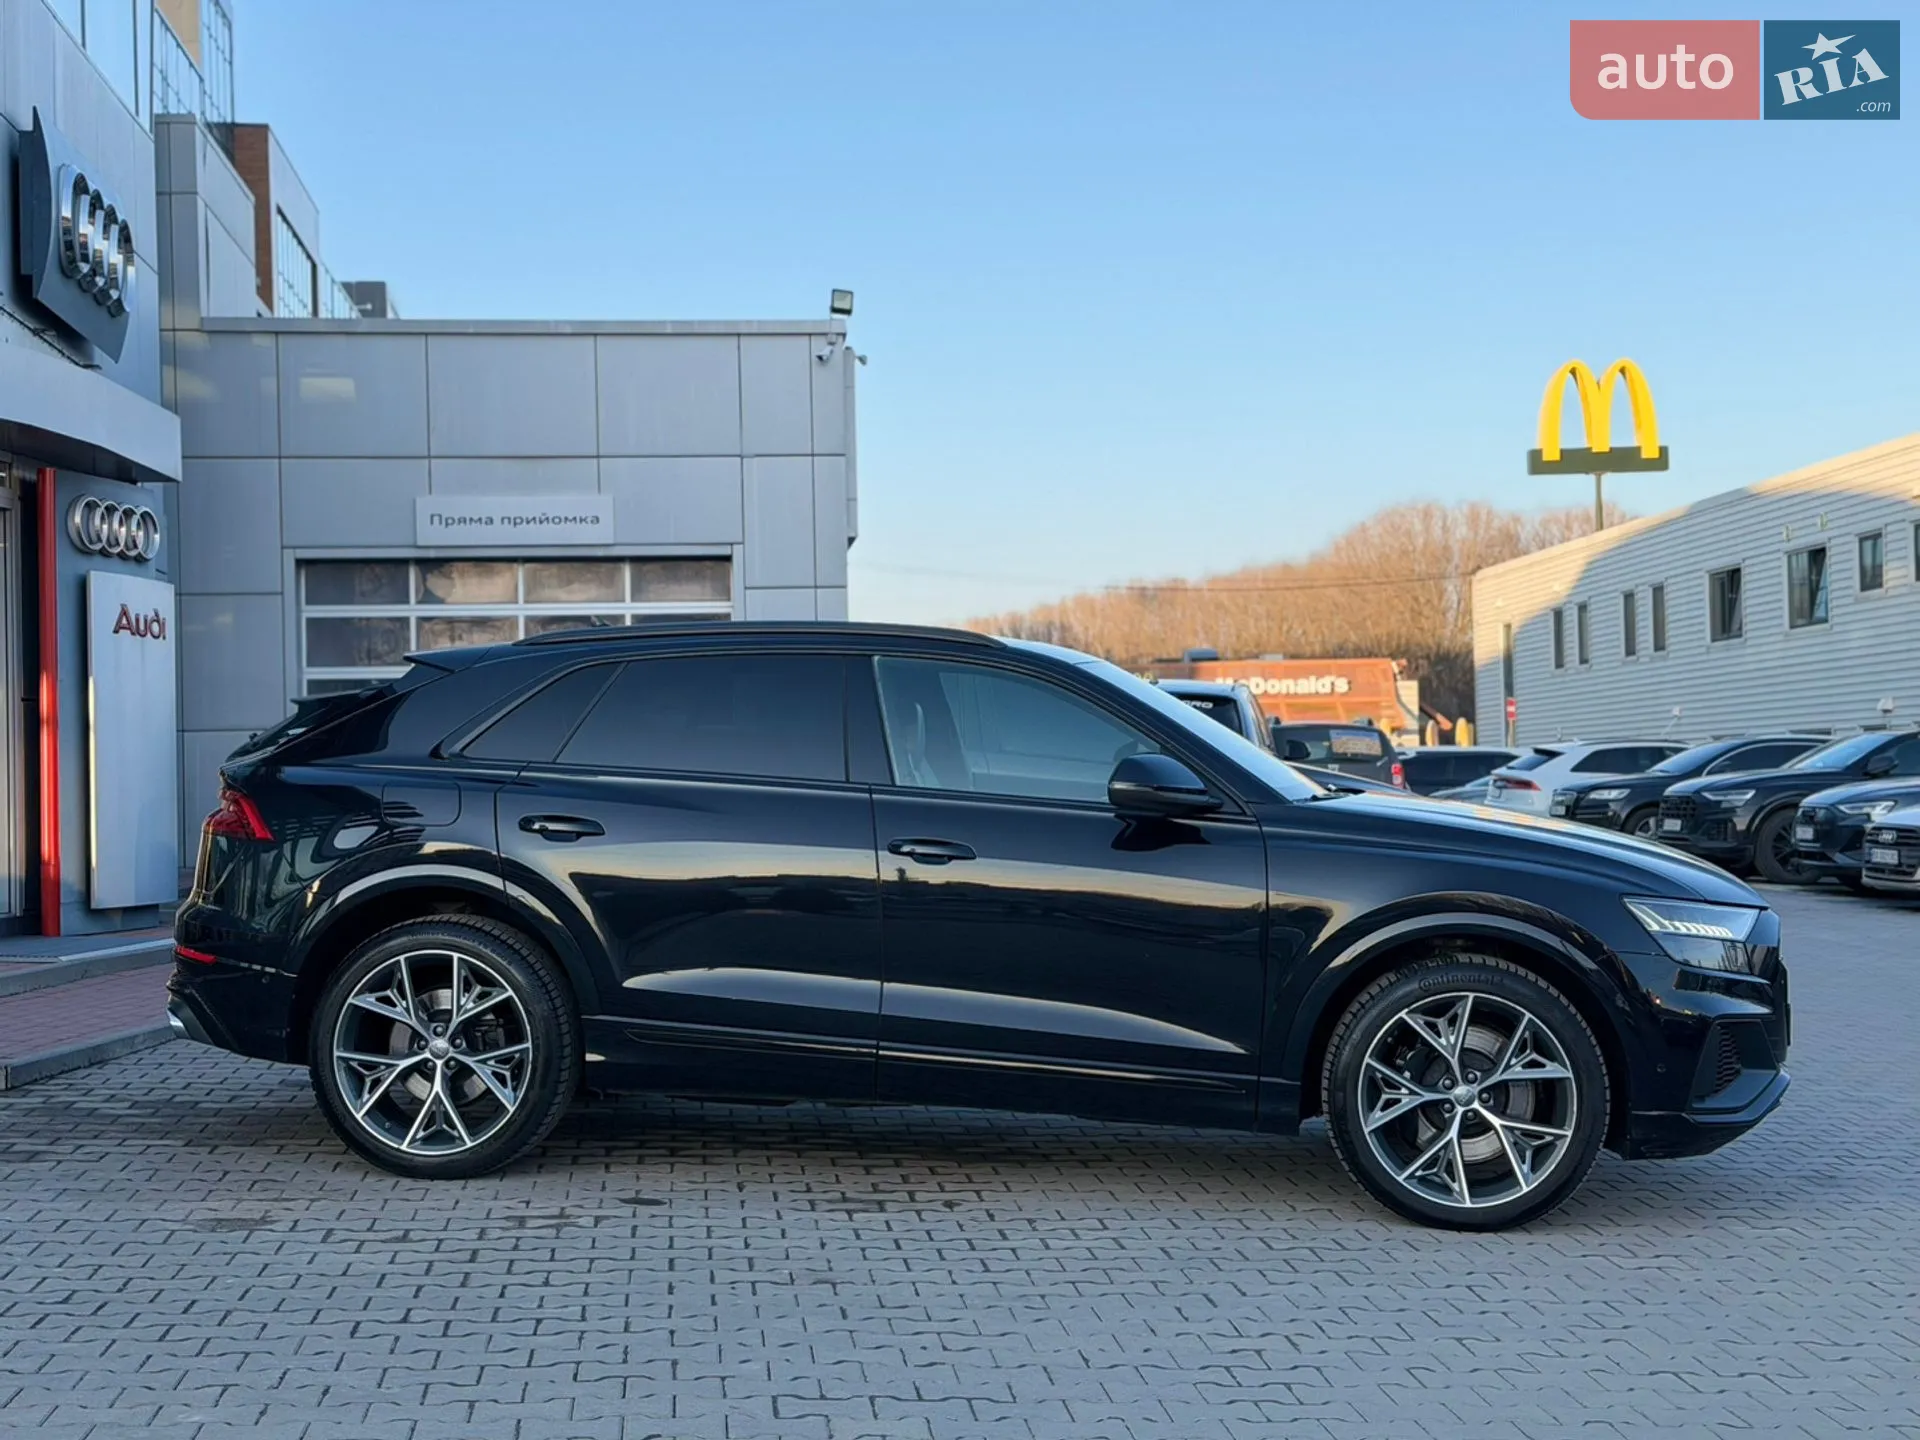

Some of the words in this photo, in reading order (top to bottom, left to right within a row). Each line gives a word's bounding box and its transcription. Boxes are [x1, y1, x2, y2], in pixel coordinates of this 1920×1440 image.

[429, 513, 494, 528] Пряма
[500, 512, 600, 528] прийомка
[112, 603, 167, 640] Audi
